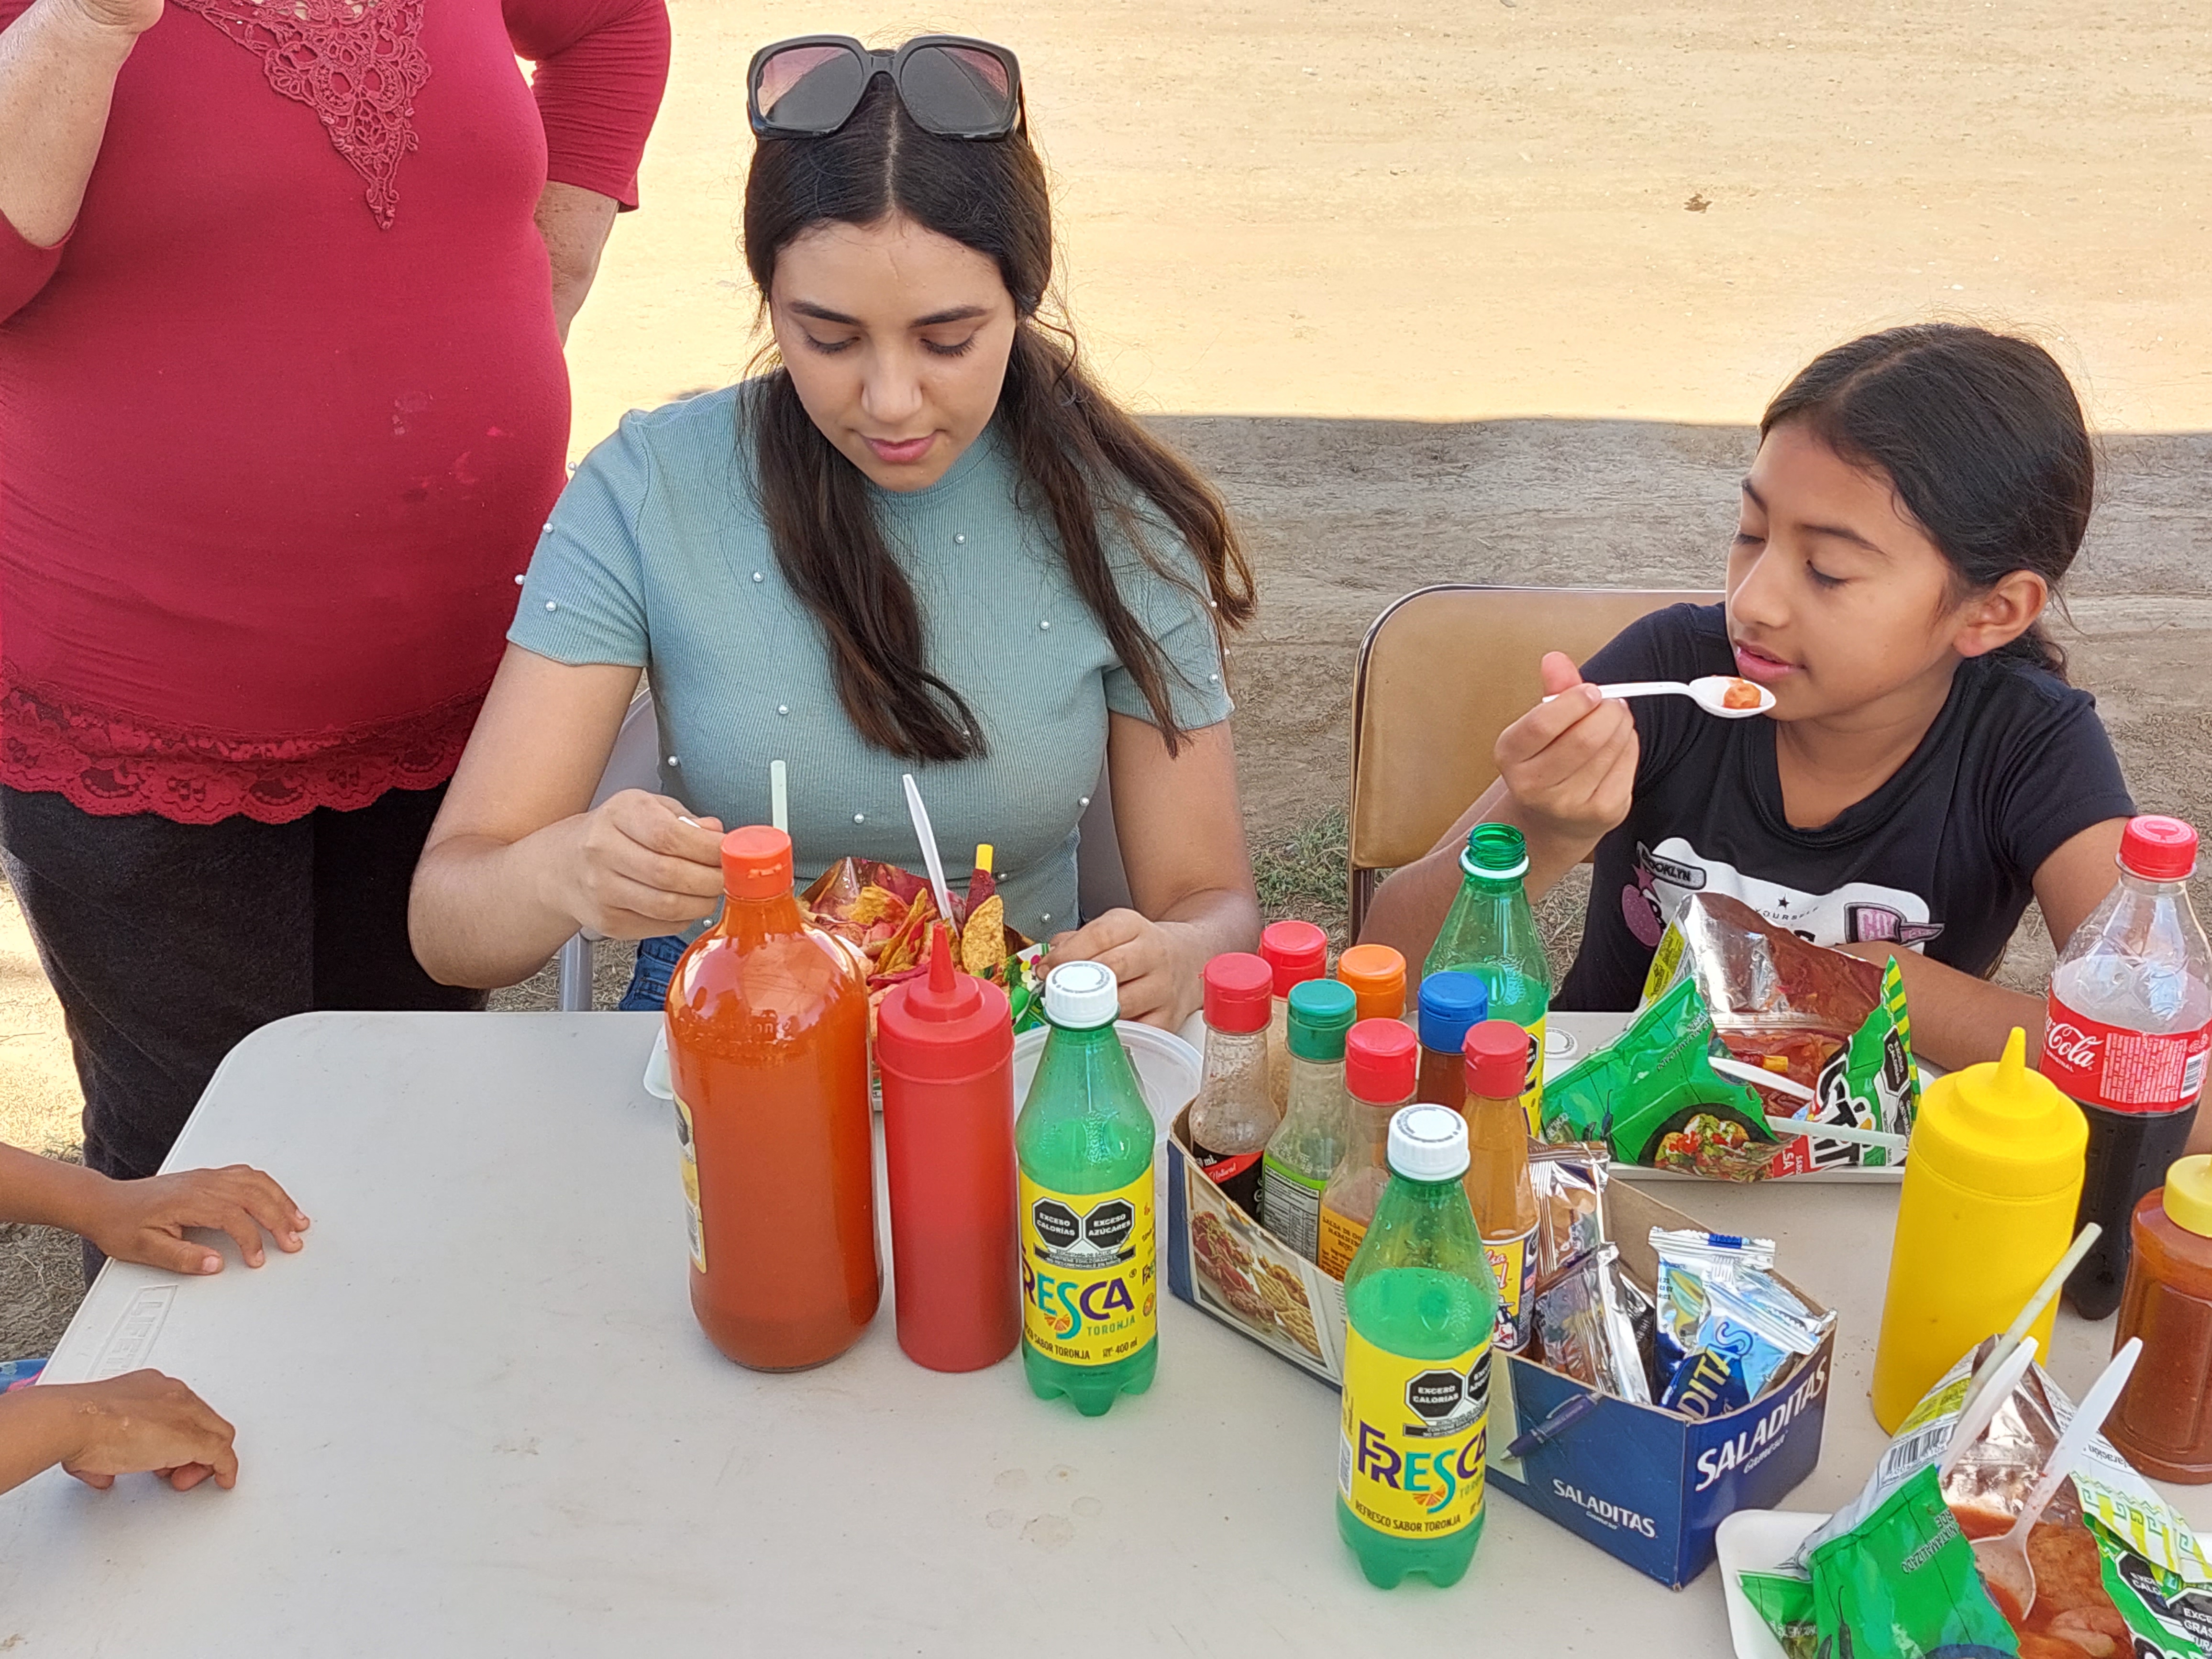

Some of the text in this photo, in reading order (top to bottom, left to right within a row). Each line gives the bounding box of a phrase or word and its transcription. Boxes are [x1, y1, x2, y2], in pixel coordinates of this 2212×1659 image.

[1037, 1219, 1075, 1237] CALORÍAS
[1039, 1212, 1071, 1227] EXCESO
[1088, 1219, 1131, 1236] AZÚCARES
[1093, 1213, 1126, 1228] EXCESO
[1025, 1272, 1135, 1339] RESCA
[1087, 1315, 1136, 1336] TORONJA
[1034, 1333, 1053, 1353] SABOR
[1055, 1344, 1091, 1360] TORONJA
[1115, 1341, 1129, 1354] 400
[1677, 1321, 1754, 1419] DITAS
[1418, 1385, 1456, 1394] EXCESO
[1695, 1355, 1827, 1492] SALADITAS
[1355, 1499, 1460, 1532] REFRESCO SABOR TORONJA
[1553, 1478, 1656, 1538] SALADITAS
[2132, 1579, 2162, 1596] CALO
[2183, 1607, 2212, 1624] EXCE
[2183, 1620, 2212, 1637] GRAS
